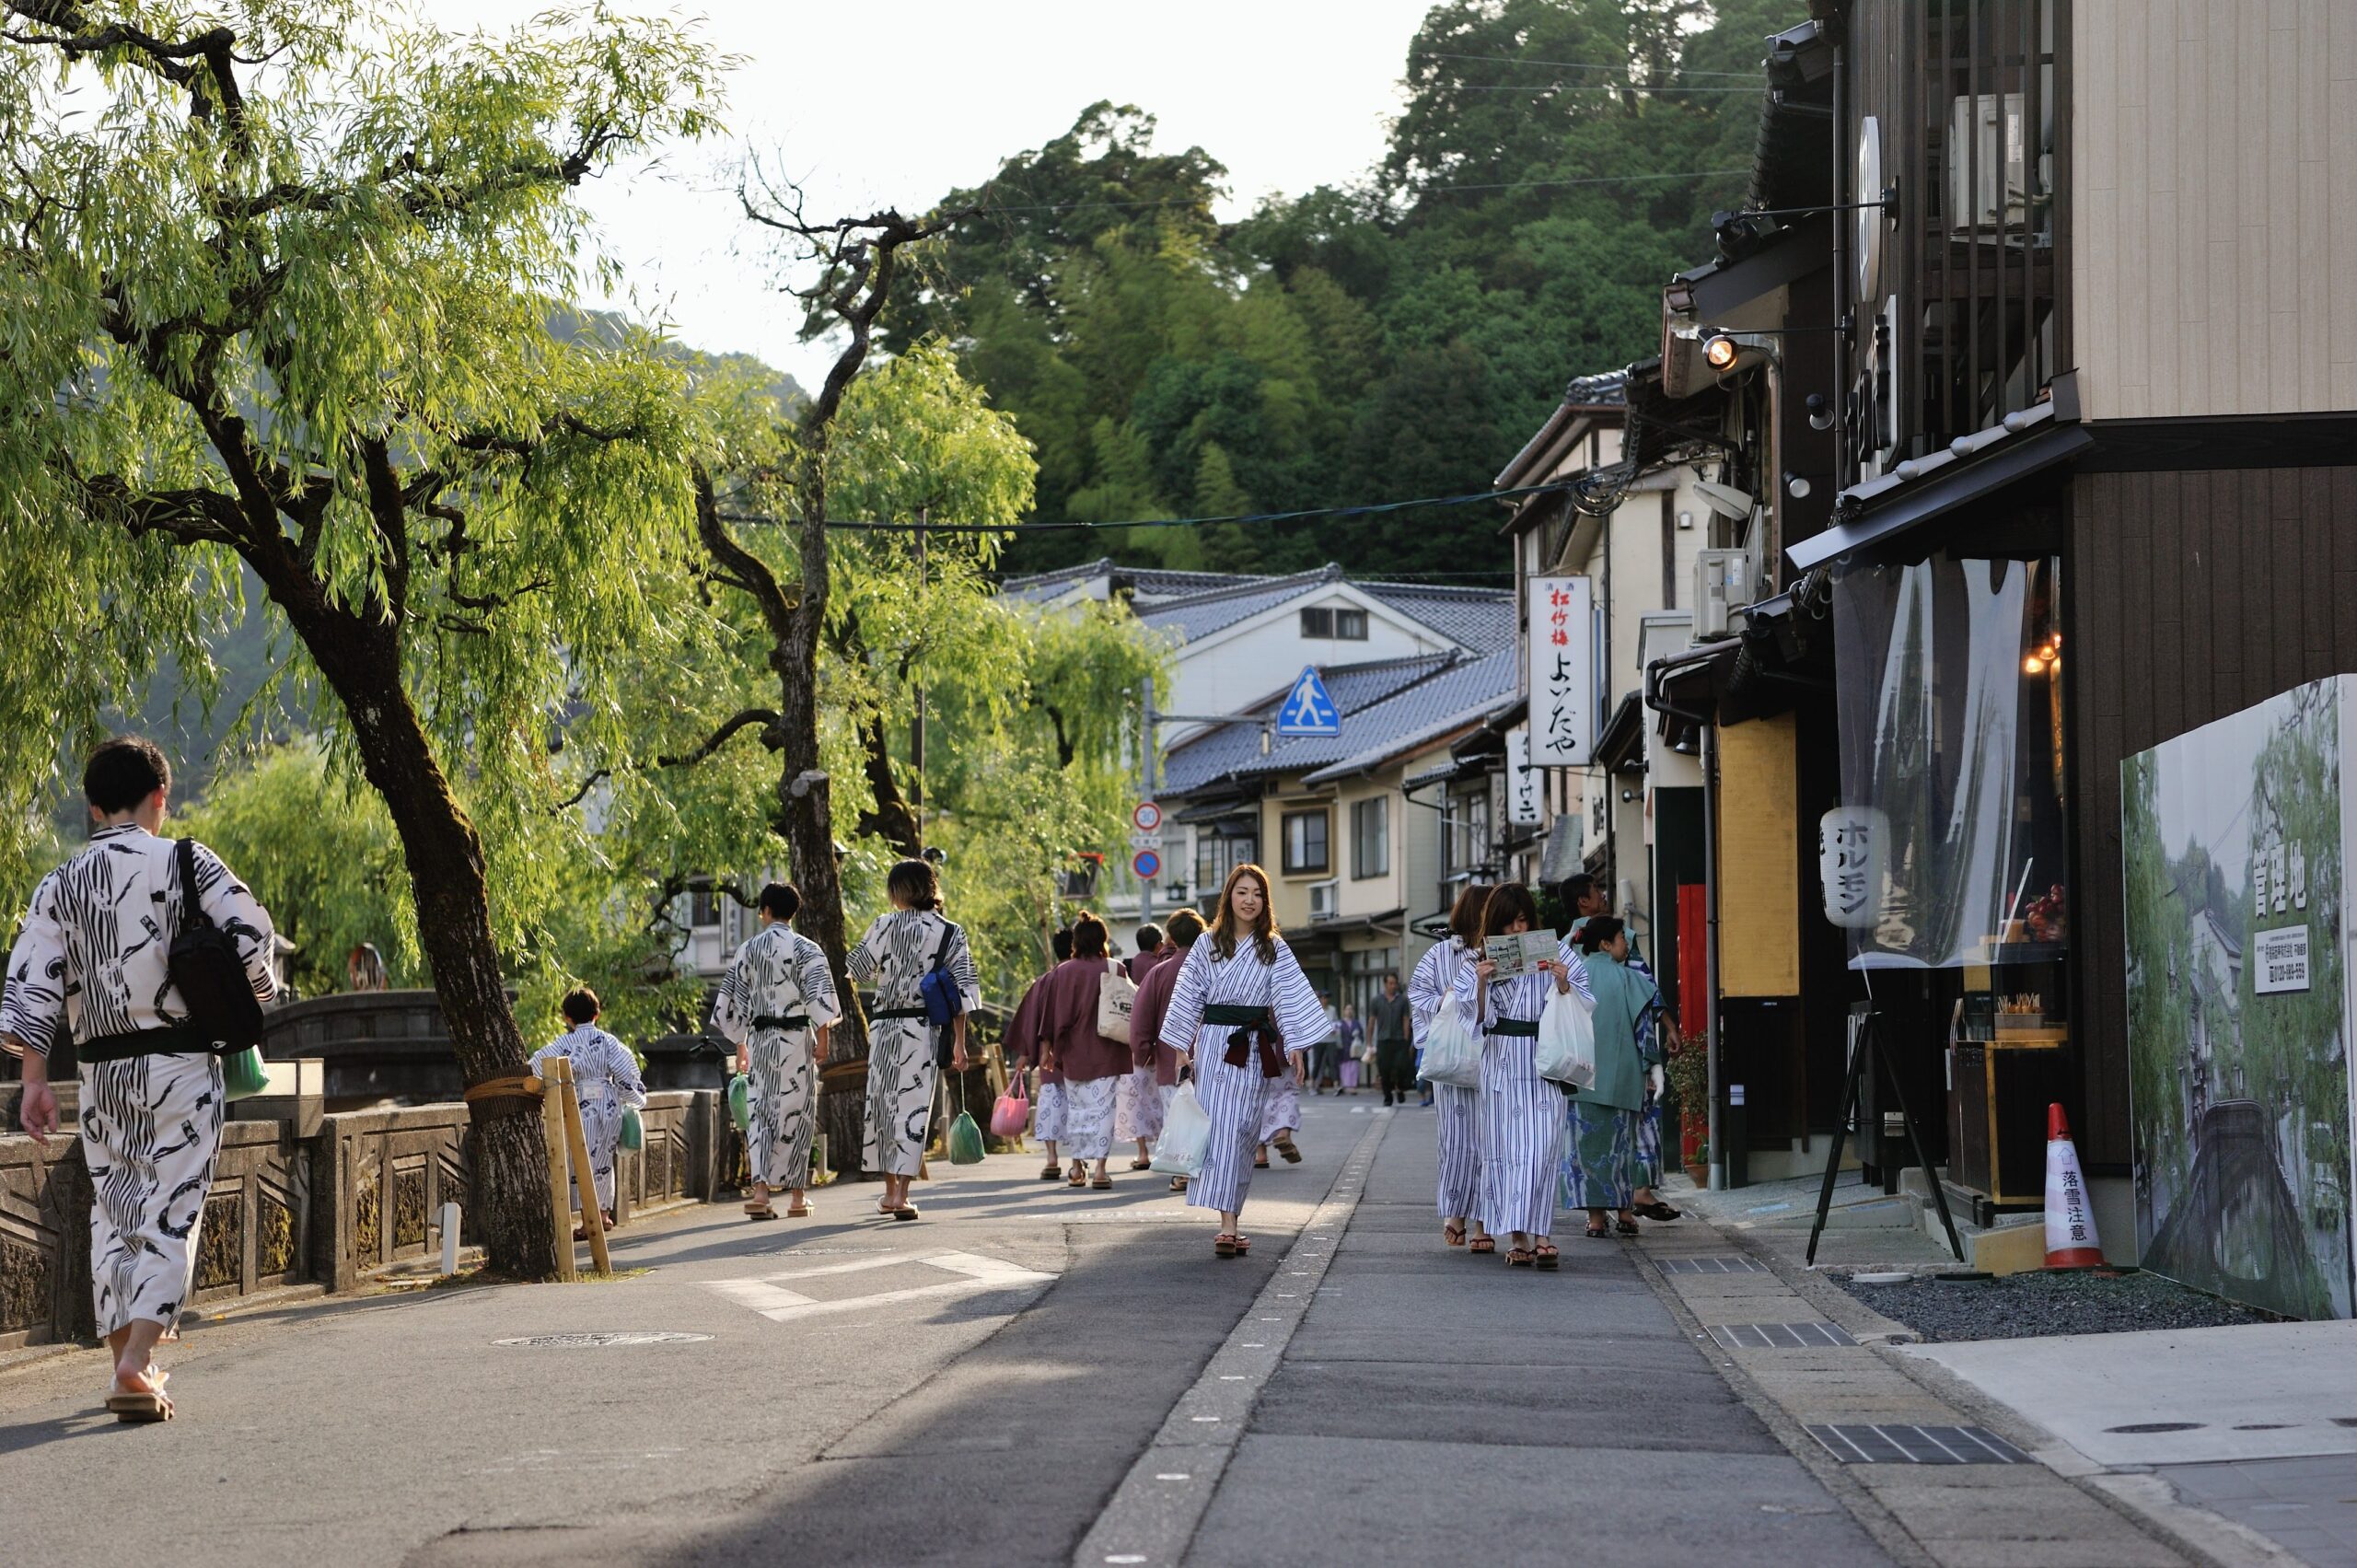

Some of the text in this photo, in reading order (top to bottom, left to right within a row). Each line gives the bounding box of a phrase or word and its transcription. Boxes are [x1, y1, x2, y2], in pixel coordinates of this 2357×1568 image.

[1545, 582, 1574, 591] 清酒
[1550, 587, 1570, 646] 松竹梅
[1139, 810, 1155, 823] 30
[1837, 819, 1868, 914] ホルモン
[2253, 838, 2307, 917] 管理地
[2061, 1170, 2087, 1241] 落雪注意
